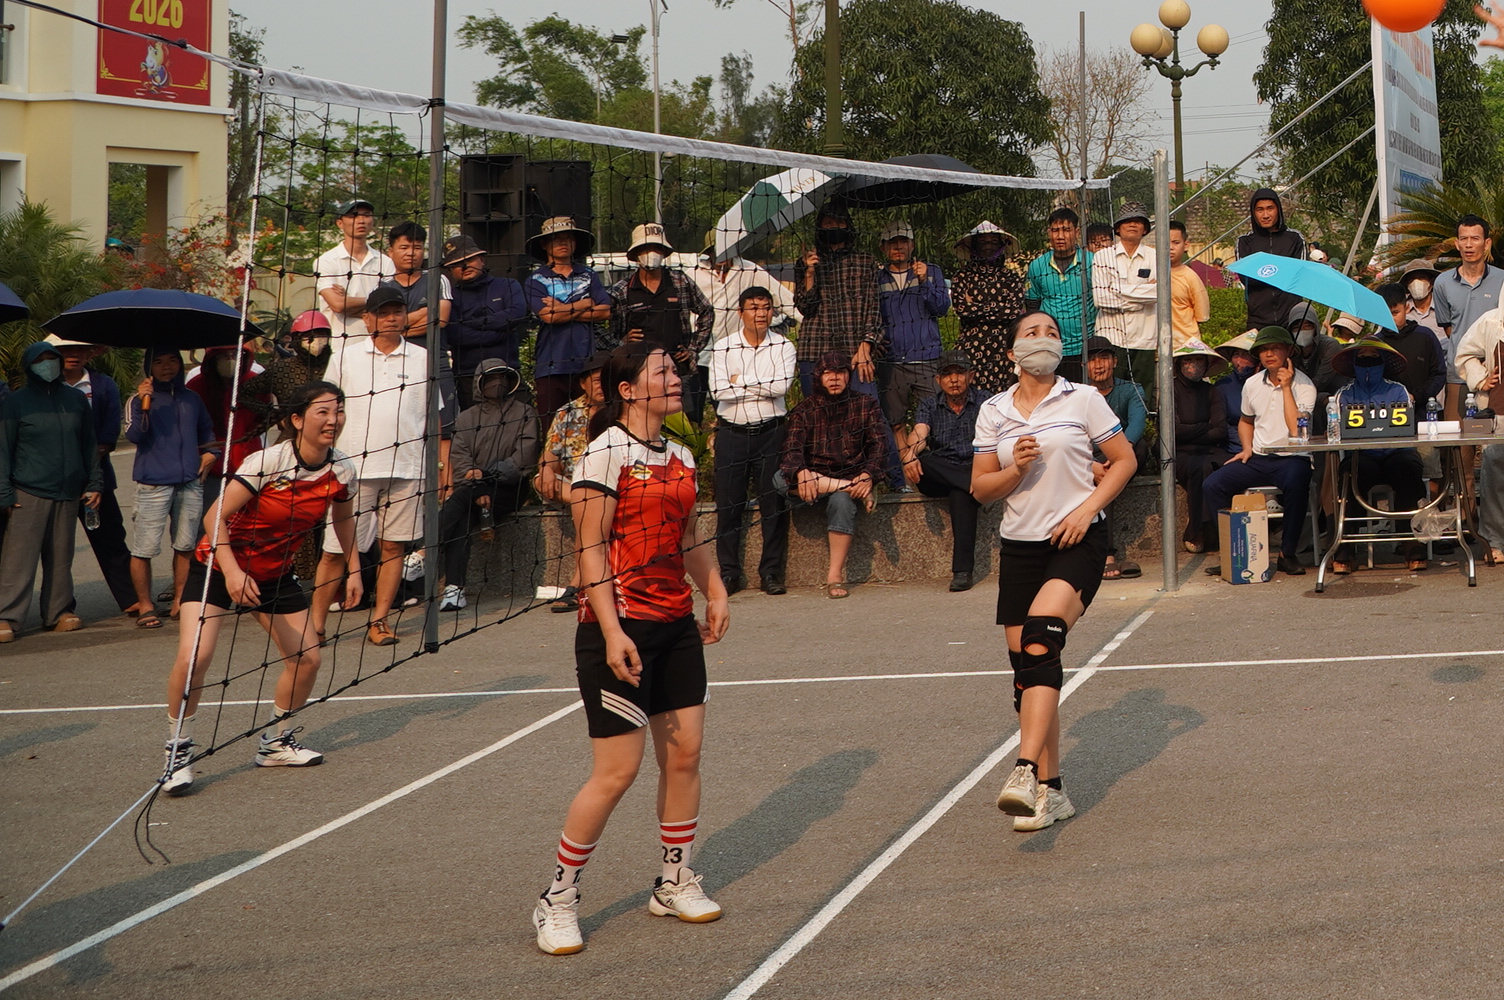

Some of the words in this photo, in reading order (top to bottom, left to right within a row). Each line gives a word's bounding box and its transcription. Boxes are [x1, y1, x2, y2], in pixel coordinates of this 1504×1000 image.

[645, 226, 662, 236] DIOR
[1348, 410, 1364, 427] 5
[1391, 408, 1408, 426] 5
[1249, 532, 1257, 563] AQUAFINA
